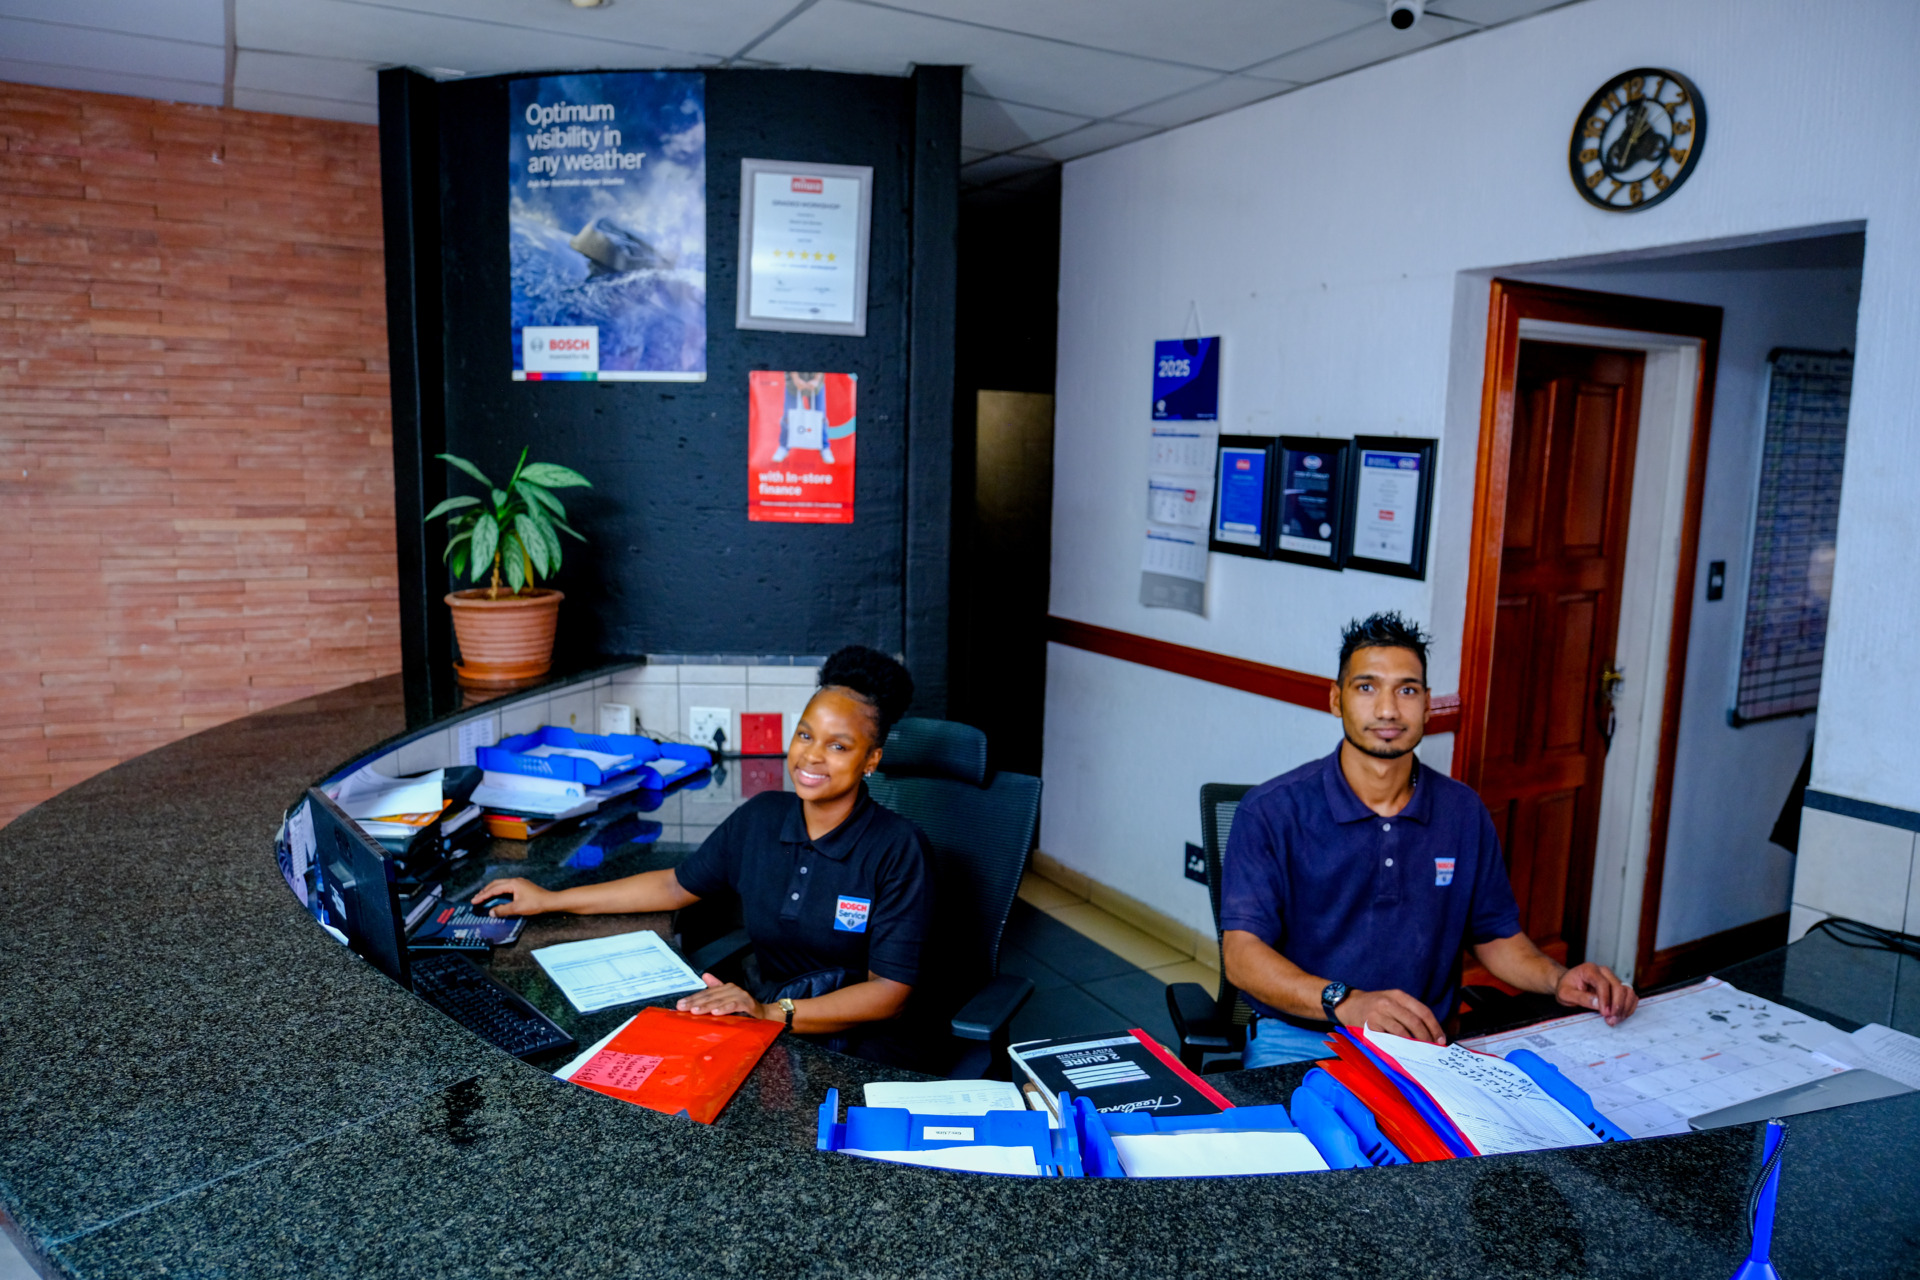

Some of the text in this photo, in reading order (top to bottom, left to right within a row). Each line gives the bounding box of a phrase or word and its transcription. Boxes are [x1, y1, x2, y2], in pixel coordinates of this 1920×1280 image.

[1622, 77, 1645, 102] 12
[526, 100, 615, 129] Optimum
[526, 125, 622, 152] visibility in
[527, 148, 646, 177] any weather
[549, 339, 590, 351] BOSCH
[1158, 359, 1190, 377] 2025
[758, 470, 784, 483] with
[759, 483, 802, 496] finance
[840, 902, 867, 912] BOSCH
[838, 910, 866, 920] Service
[1061, 1055, 1109, 1067] QUIRE
